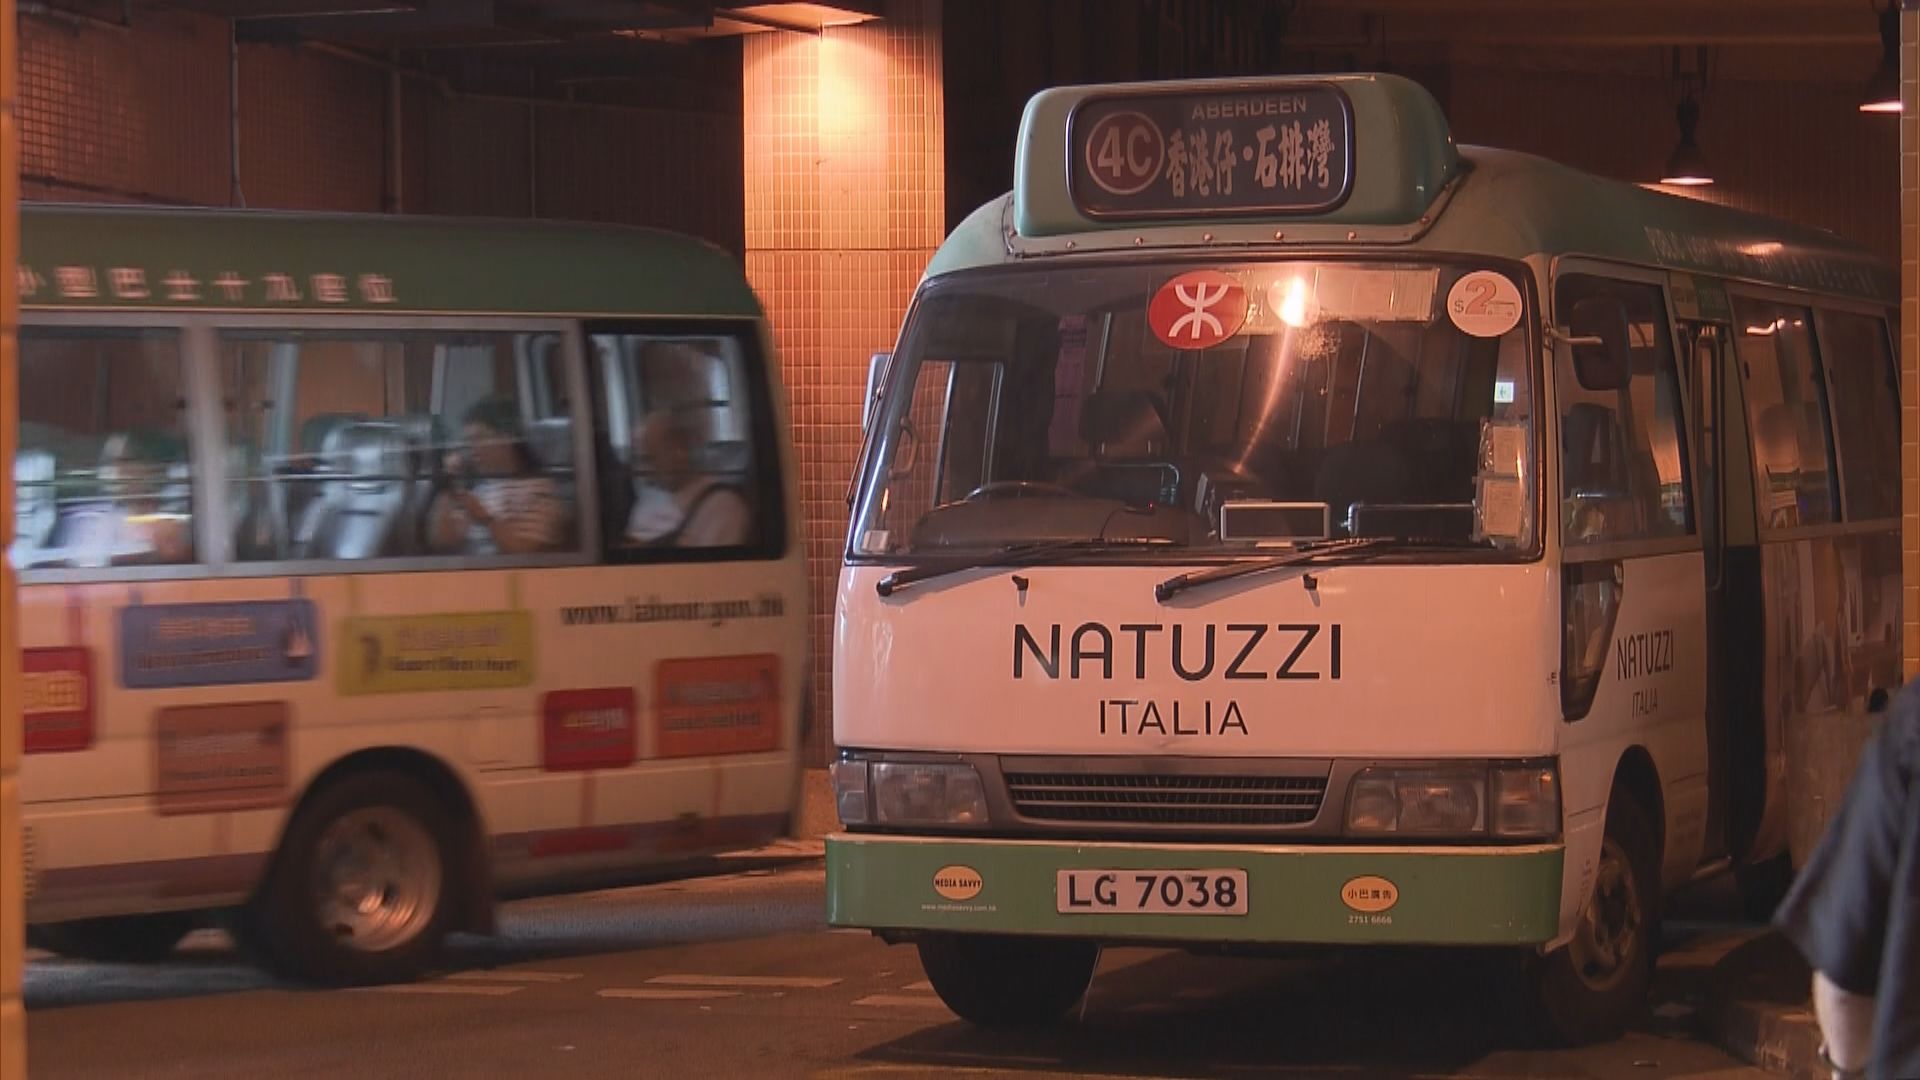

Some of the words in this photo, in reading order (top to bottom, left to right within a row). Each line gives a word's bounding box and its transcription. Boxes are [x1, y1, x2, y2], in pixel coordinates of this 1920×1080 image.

[1191, 96, 1307, 120] ABERDEEN
[1097, 125, 1152, 178] 4C
[1013, 623, 1342, 681] NATUZZI
[1616, 628, 1674, 681] NATUZZI
[1099, 699, 1249, 737] ITALIA
[1631, 688, 1658, 719] ITALIA
[935, 878, 957, 888] MEDIA
[959, 878, 981, 888] SAVVY
[1068, 874, 1118, 907] LG
[1135, 875, 1238, 908] 7038
